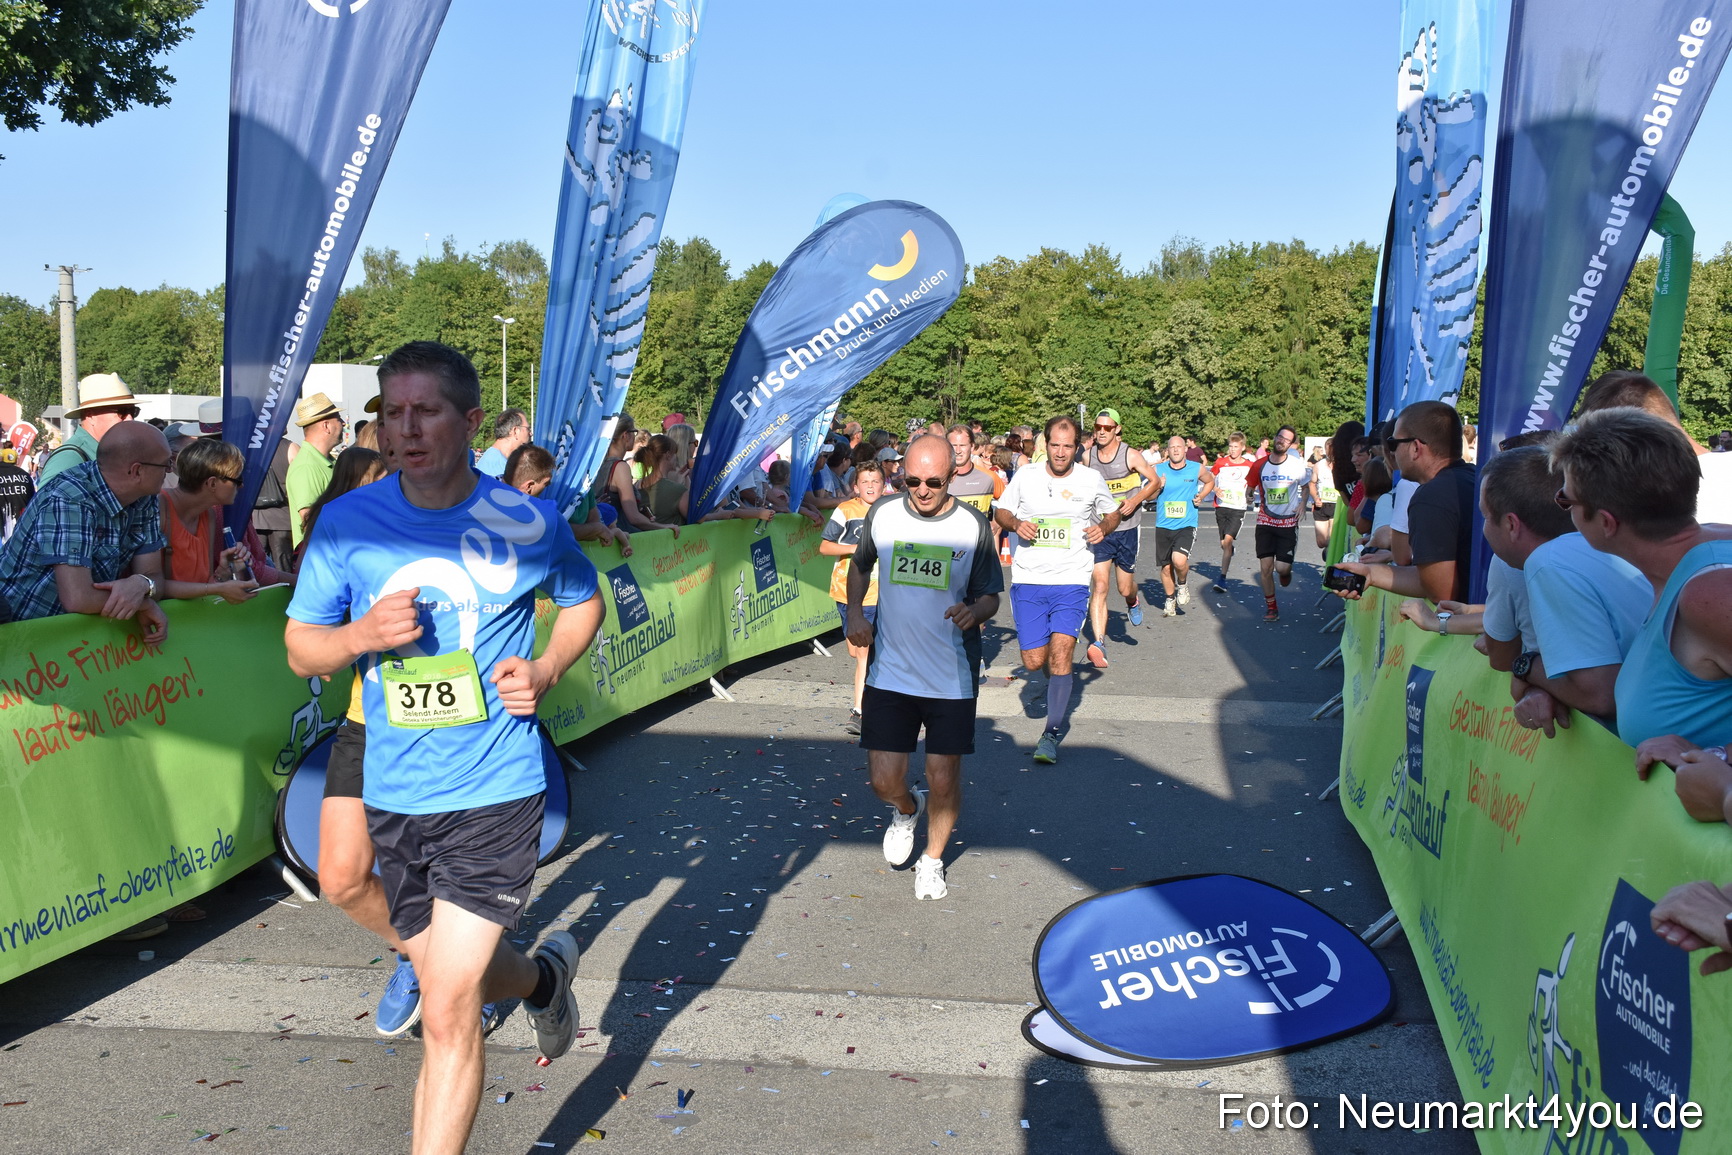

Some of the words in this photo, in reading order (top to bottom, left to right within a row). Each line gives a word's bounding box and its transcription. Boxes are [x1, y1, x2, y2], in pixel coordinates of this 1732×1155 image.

[1520, 16, 1712, 434] www.fischer-automobile.de
[247, 112, 382, 450] www.fischer-automobile.de
[1661, 283, 1669, 295] Die
[835, 326, 875, 361] Druck
[873, 303, 902, 336] und
[899, 267, 949, 309] Medien
[730, 287, 890, 420] Frischmann
[1167, 506, 1184, 514] 1940
[618, 583, 637, 600] Fischer
[897, 557, 943, 577] 2148
[458, 598, 479, 613] als
[67, 632, 164, 681] Firmen
[609, 601, 676, 676] firmenlauf
[398, 681, 456, 709] 378
[616, 659, 646, 688] neumarkt
[13, 703, 106, 766] laufen
[103, 656, 204, 729] länger!
[1089, 920, 1248, 972] AUTOMOBILE
[1098, 938, 1298, 1010] Fischer
[1610, 953, 1675, 1030] Fischer
[1615, 1002, 1671, 1055] AUTOMOBILE
[1643, 1060, 1656, 1088] das
